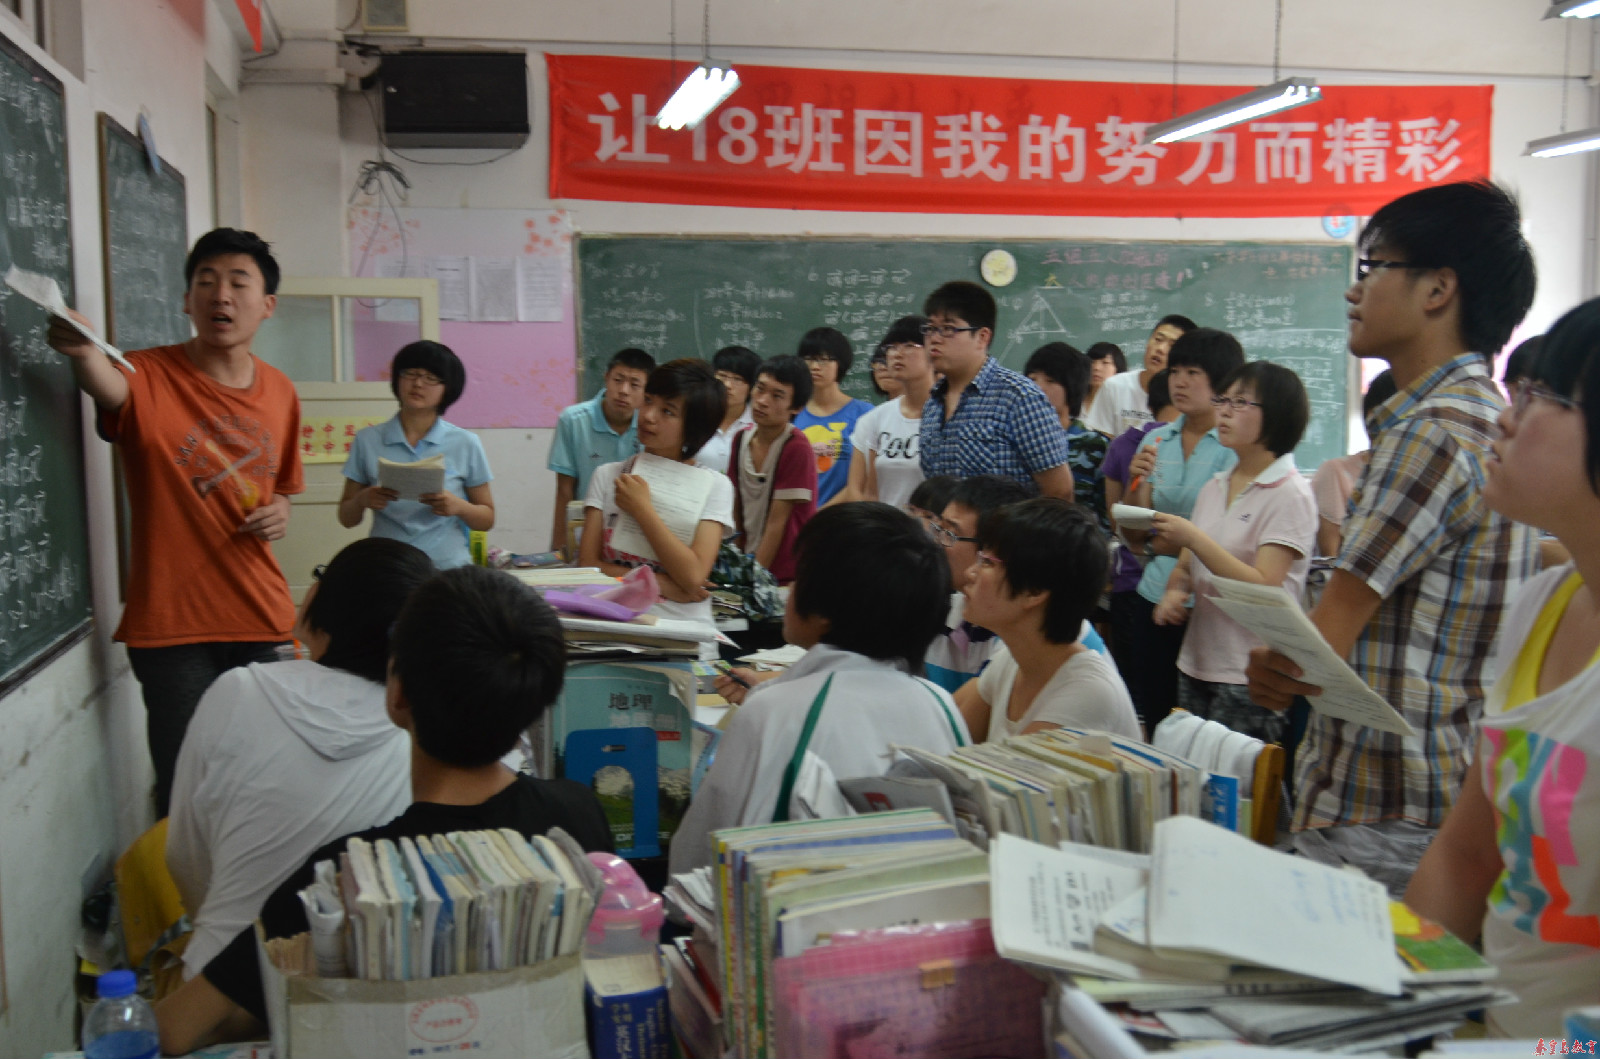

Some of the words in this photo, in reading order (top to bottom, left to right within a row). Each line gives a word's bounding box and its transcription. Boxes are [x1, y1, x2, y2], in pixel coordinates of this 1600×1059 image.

[588, 92, 1462, 186] 让18班因我的努力而精彩
[608, 691, 653, 711] 地理
